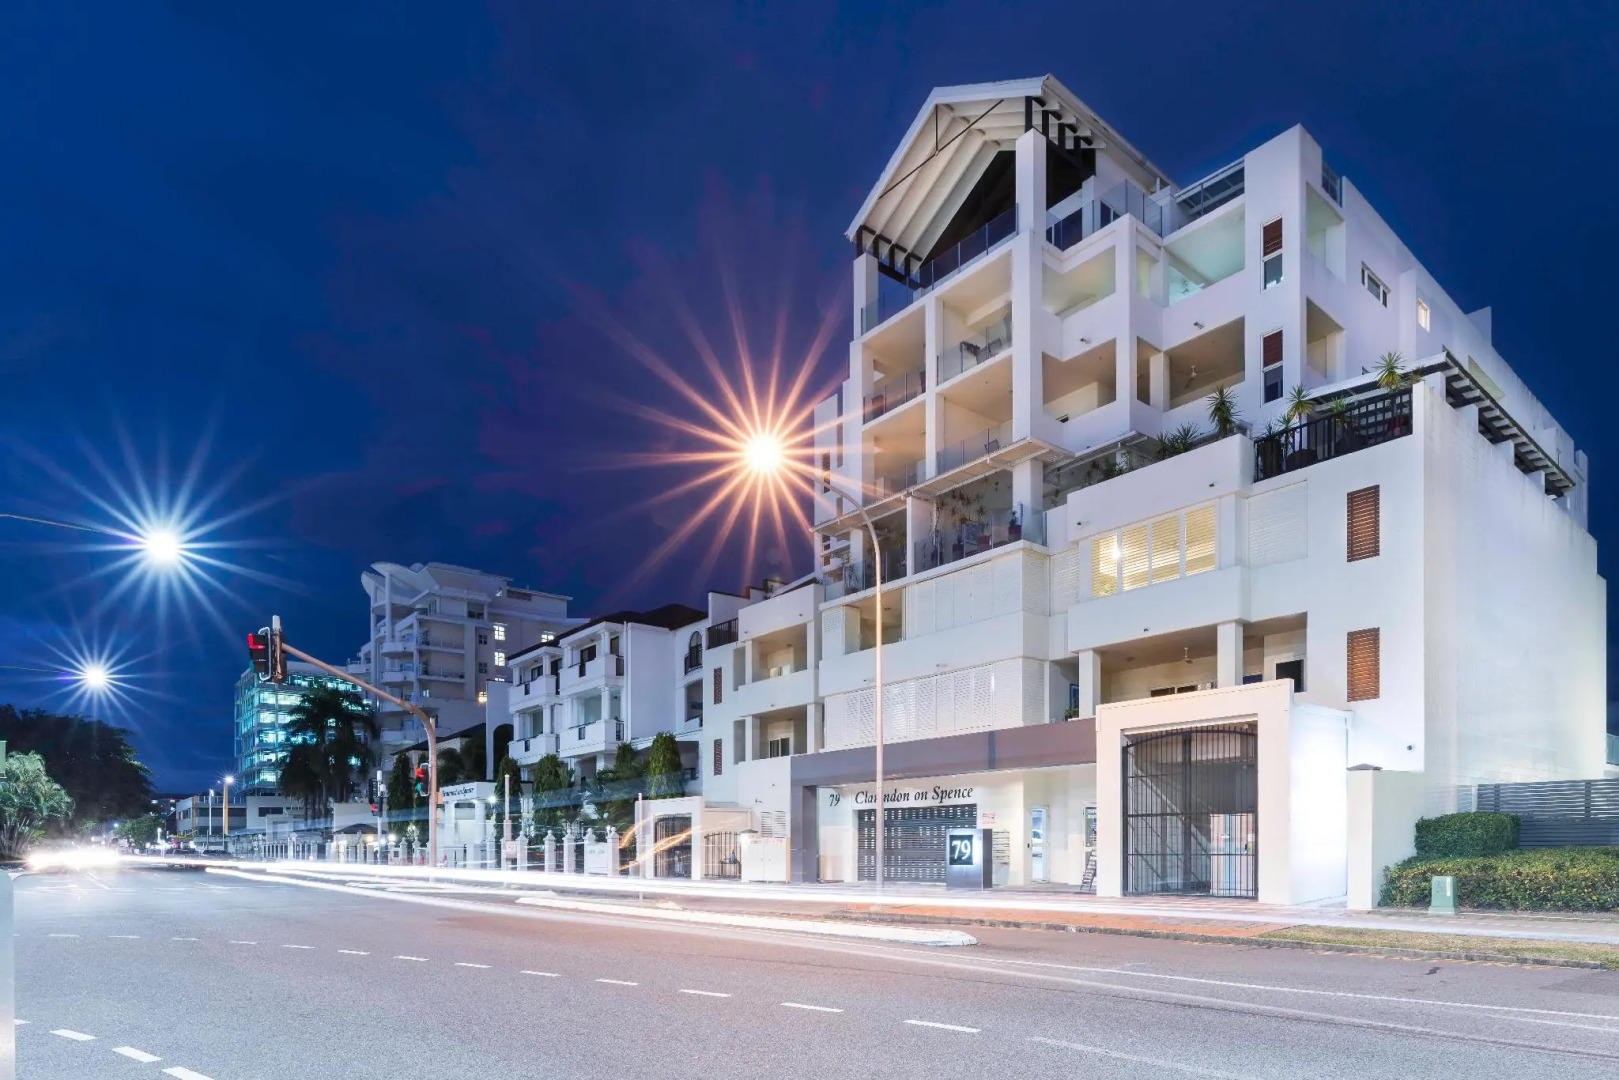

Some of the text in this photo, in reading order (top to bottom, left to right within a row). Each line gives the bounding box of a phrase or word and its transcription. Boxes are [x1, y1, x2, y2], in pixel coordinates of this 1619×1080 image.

[829, 793, 841, 806] 79
[855, 785, 973, 804] Clarndon on Spence
[951, 839, 971, 860] 79
